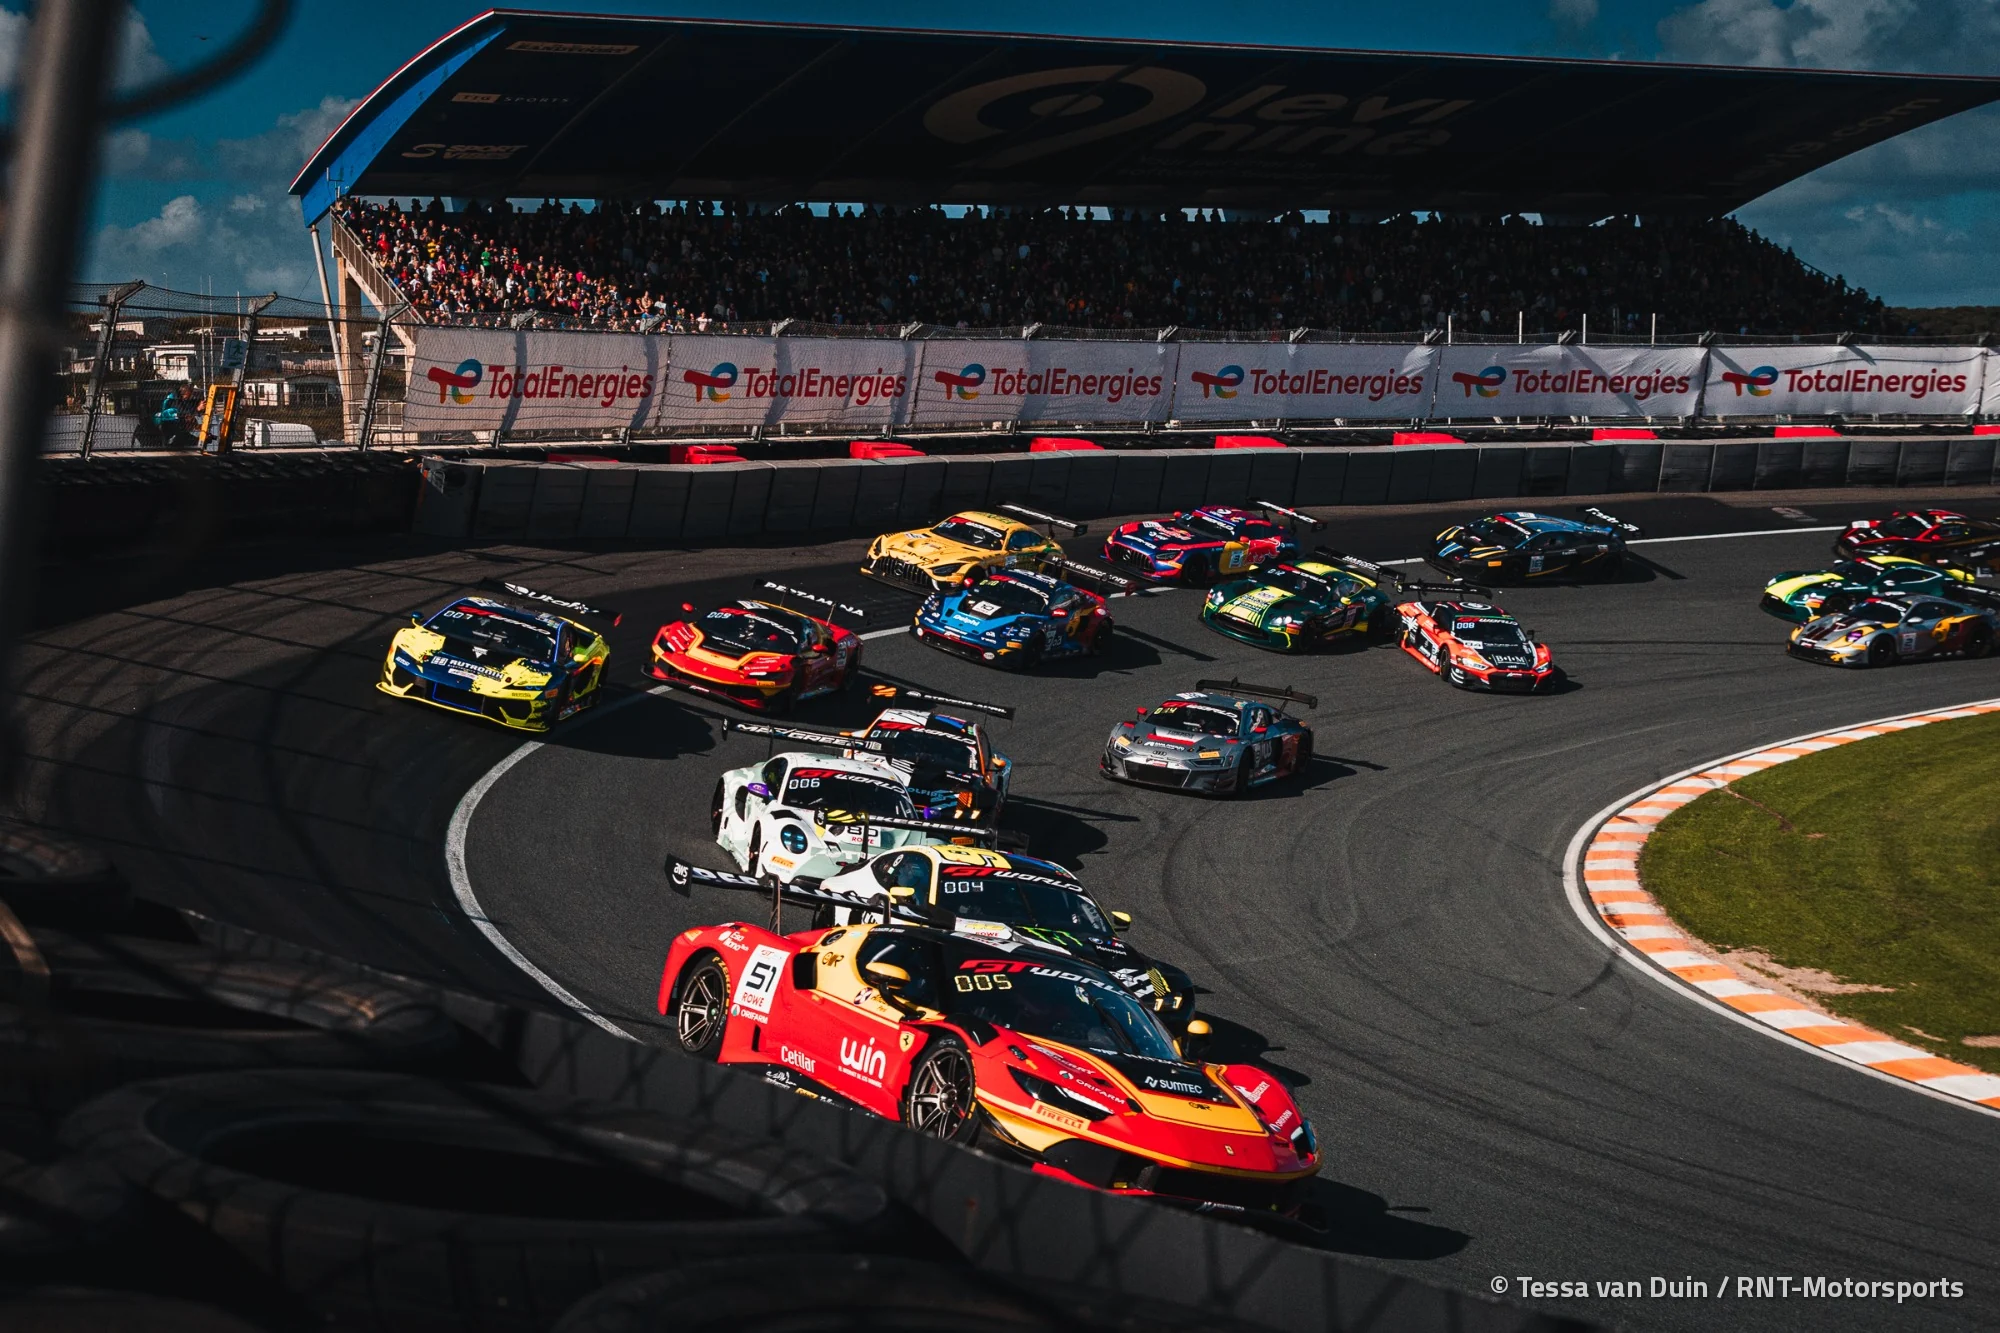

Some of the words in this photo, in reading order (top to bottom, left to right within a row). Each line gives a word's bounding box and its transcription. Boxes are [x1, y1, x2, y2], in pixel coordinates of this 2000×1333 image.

[1208, 84, 1476, 124] levi
[1152, 122, 1453, 156] nine
[488, 364, 654, 408] TotalEnergies
[743, 366, 907, 405] TotalEnergies
[991, 366, 1162, 403] TotalEnergies
[1249, 368, 1423, 402] TotalEnergies
[1512, 366, 1690, 401] TotalEnergies
[1784, 366, 1967, 398] TotalEnergies
[763, 580, 864, 617] PETAMNA
[443, 610, 473, 620] 007
[706, 611, 732, 619] 009
[744, 614, 795, 635] WORLD
[953, 615, 980, 627] Delphi
[1479, 617, 1518, 626] WORLD
[1186, 703, 1238, 719] WORLD
[870, 730, 899, 739] 011
[876, 721, 925, 732] GT
[911, 726, 977, 746] WORLD
[788, 778, 821, 790] 006
[793, 768, 846, 779] GT
[834, 773, 907, 795] WORLD
[851, 836, 875, 844] ROE
[673, 862, 689, 878] aws
[771, 855, 795, 869] PIRELLI
[942, 866, 1010, 877] GT
[993, 871, 1083, 893] WORLD
[944, 881, 984, 893] 004
[746, 961, 777, 993] 51
[960, 959, 1045, 973] GT
[954, 974, 1013, 993] 005
[741, 992, 765, 1007] ROWE
[740, 1009, 769, 1025] ORIFARM
[780, 1045, 817, 1074] Cetilar
[840, 1036, 887, 1080] win
[1075, 1078, 1125, 1105] ORIFARM
[1159, 1079, 1203, 1094] SUMTEC
[1036, 1104, 1084, 1130] PIRELLI
